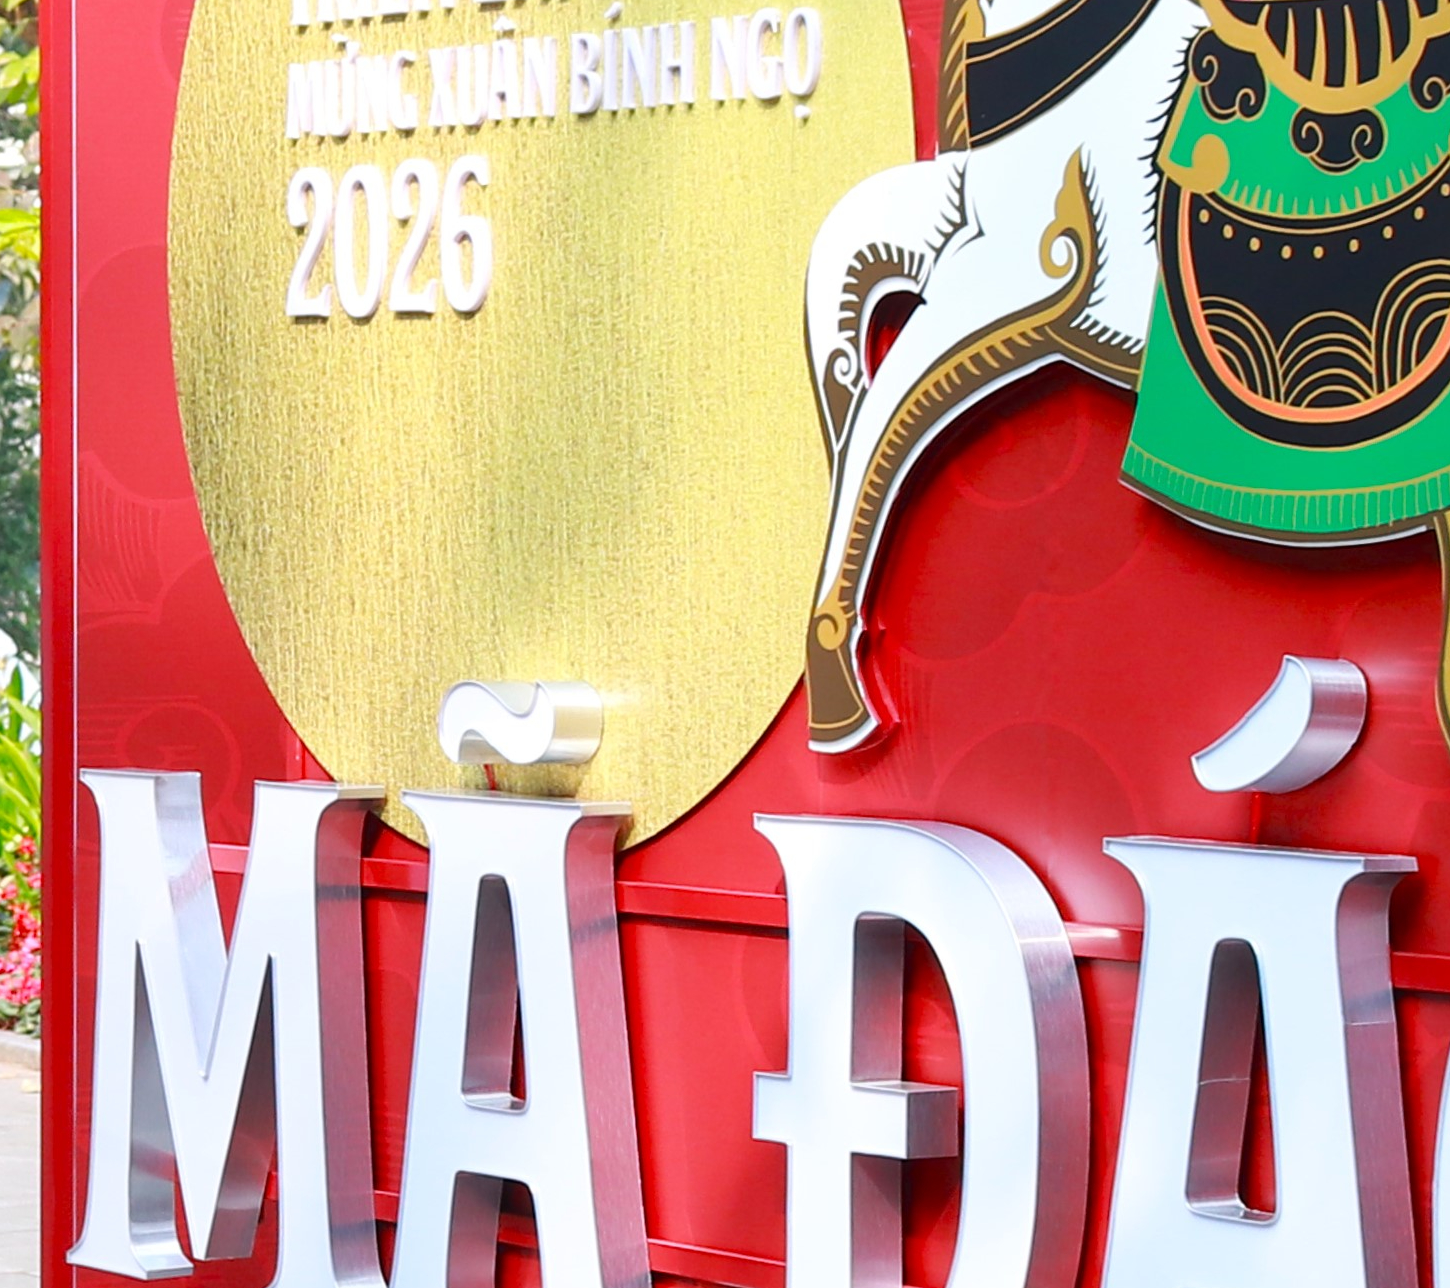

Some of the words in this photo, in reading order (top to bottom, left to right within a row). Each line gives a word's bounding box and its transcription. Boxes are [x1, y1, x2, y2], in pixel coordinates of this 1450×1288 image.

[427, 15, 558, 128] XUÂN
[569, 1, 697, 116] BÍNH
[709, 6, 823, 119] NGỌ
[285, 154, 494, 321] 2026
